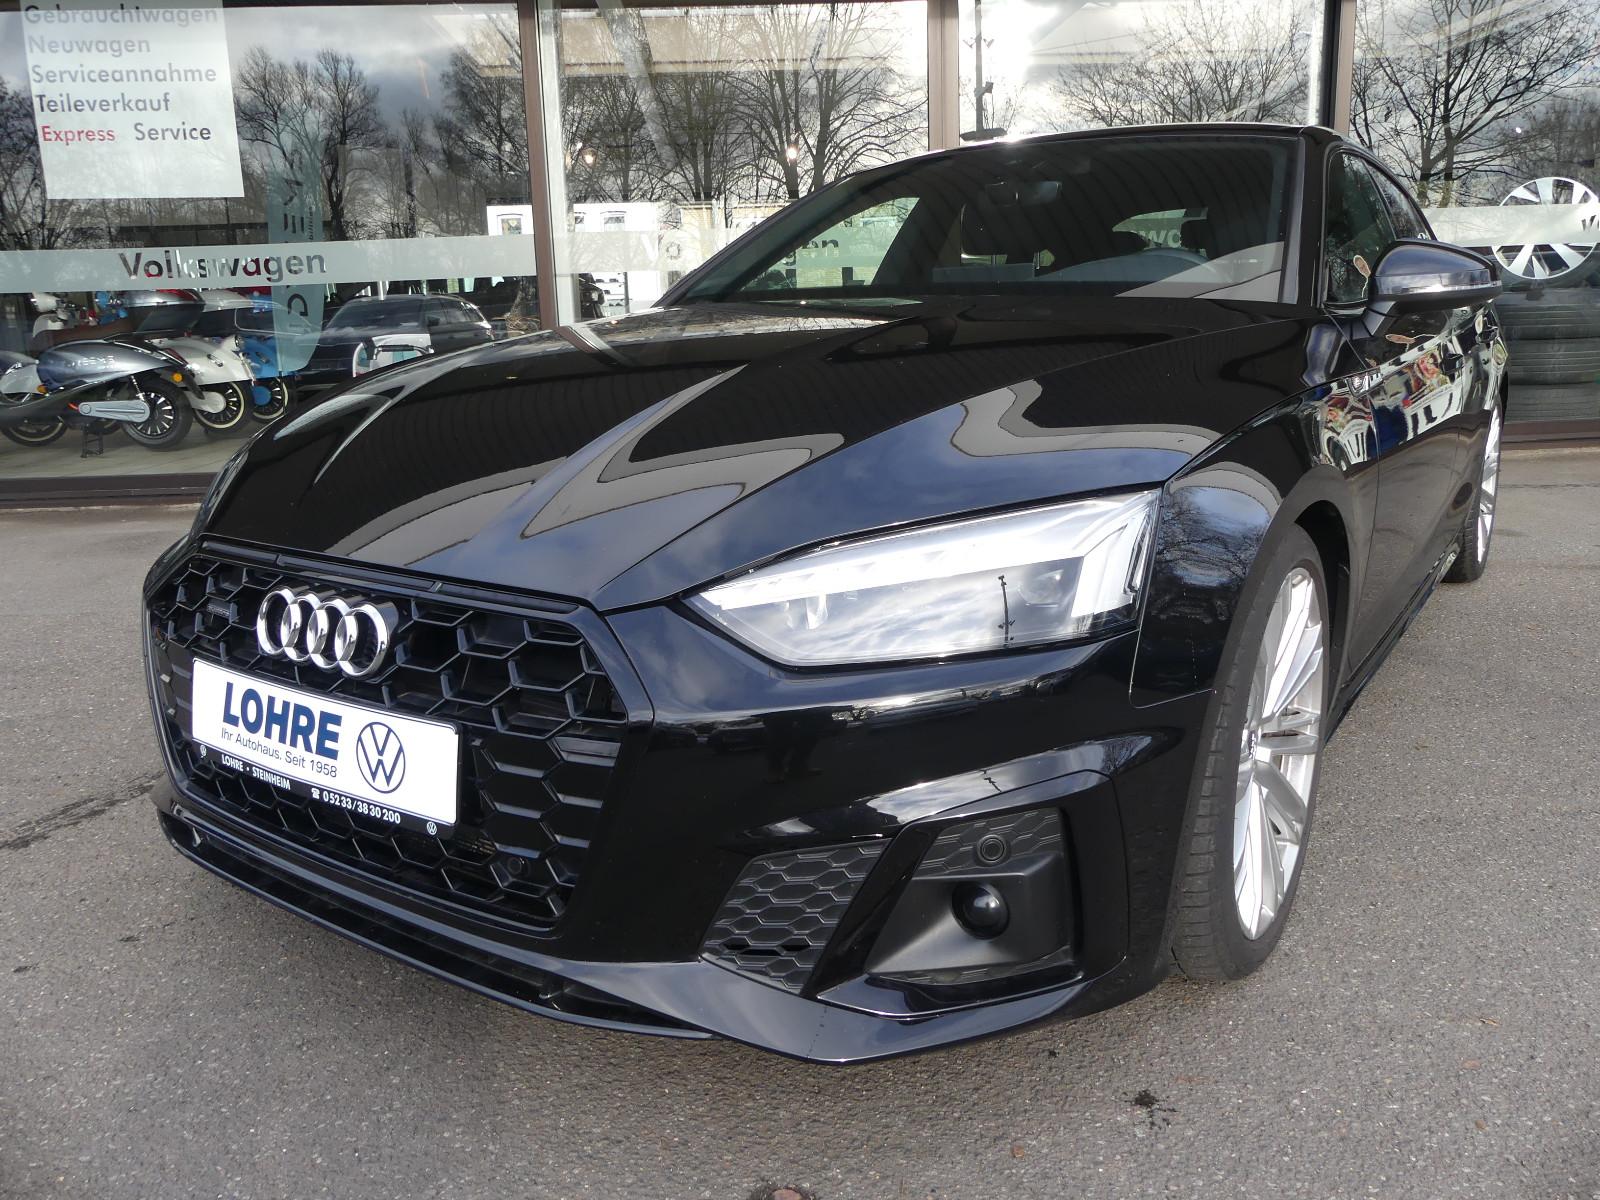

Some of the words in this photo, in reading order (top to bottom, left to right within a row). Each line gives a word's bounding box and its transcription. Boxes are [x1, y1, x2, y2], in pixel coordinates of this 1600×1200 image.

[24, 3, 218, 27] Gebrauchtwagen
[28, 35, 150, 57] Neuwagen
[31, 63, 216, 83] Serviceannahme
[36, 92, 170, 113] Teileverkauf
[41, 125, 115, 146] Express
[134, 121, 212, 141] Service
[118, 249, 326, 283] Volkswagen
[222, 681, 343, 761] LOHRE
[221, 727, 233, 741] Ihr
[284, 751, 306, 769] Seit
[309, 759, 338, 778] 1958
[221, 753, 244, 772] LOHRE
[252, 766, 291, 790] STEINHEIM
